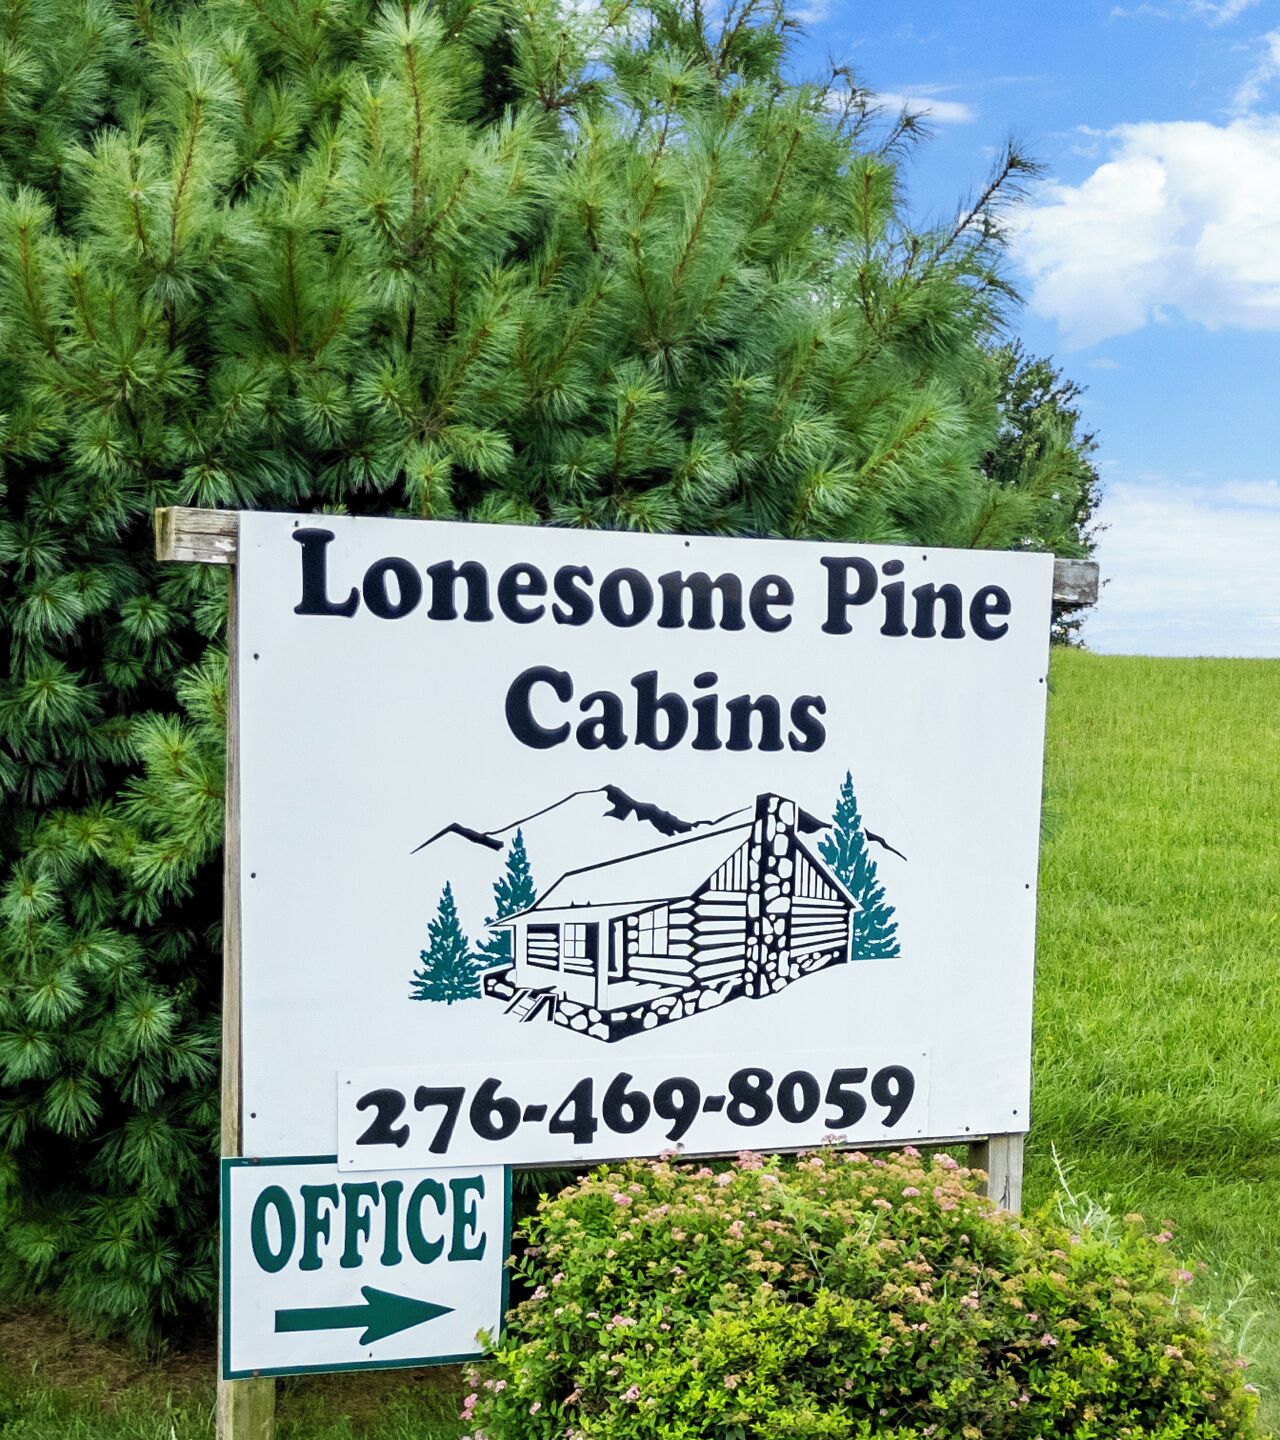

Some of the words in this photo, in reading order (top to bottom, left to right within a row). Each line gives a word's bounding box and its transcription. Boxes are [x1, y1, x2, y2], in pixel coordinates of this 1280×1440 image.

[292, 528, 793, 632] Lonesome
[820, 555, 1011, 640] Pine
[506, 666, 826, 752] Cabins
[356, 1066, 914, 1153] 276-469-8059
[251, 1175, 486, 1273] OFFICE
